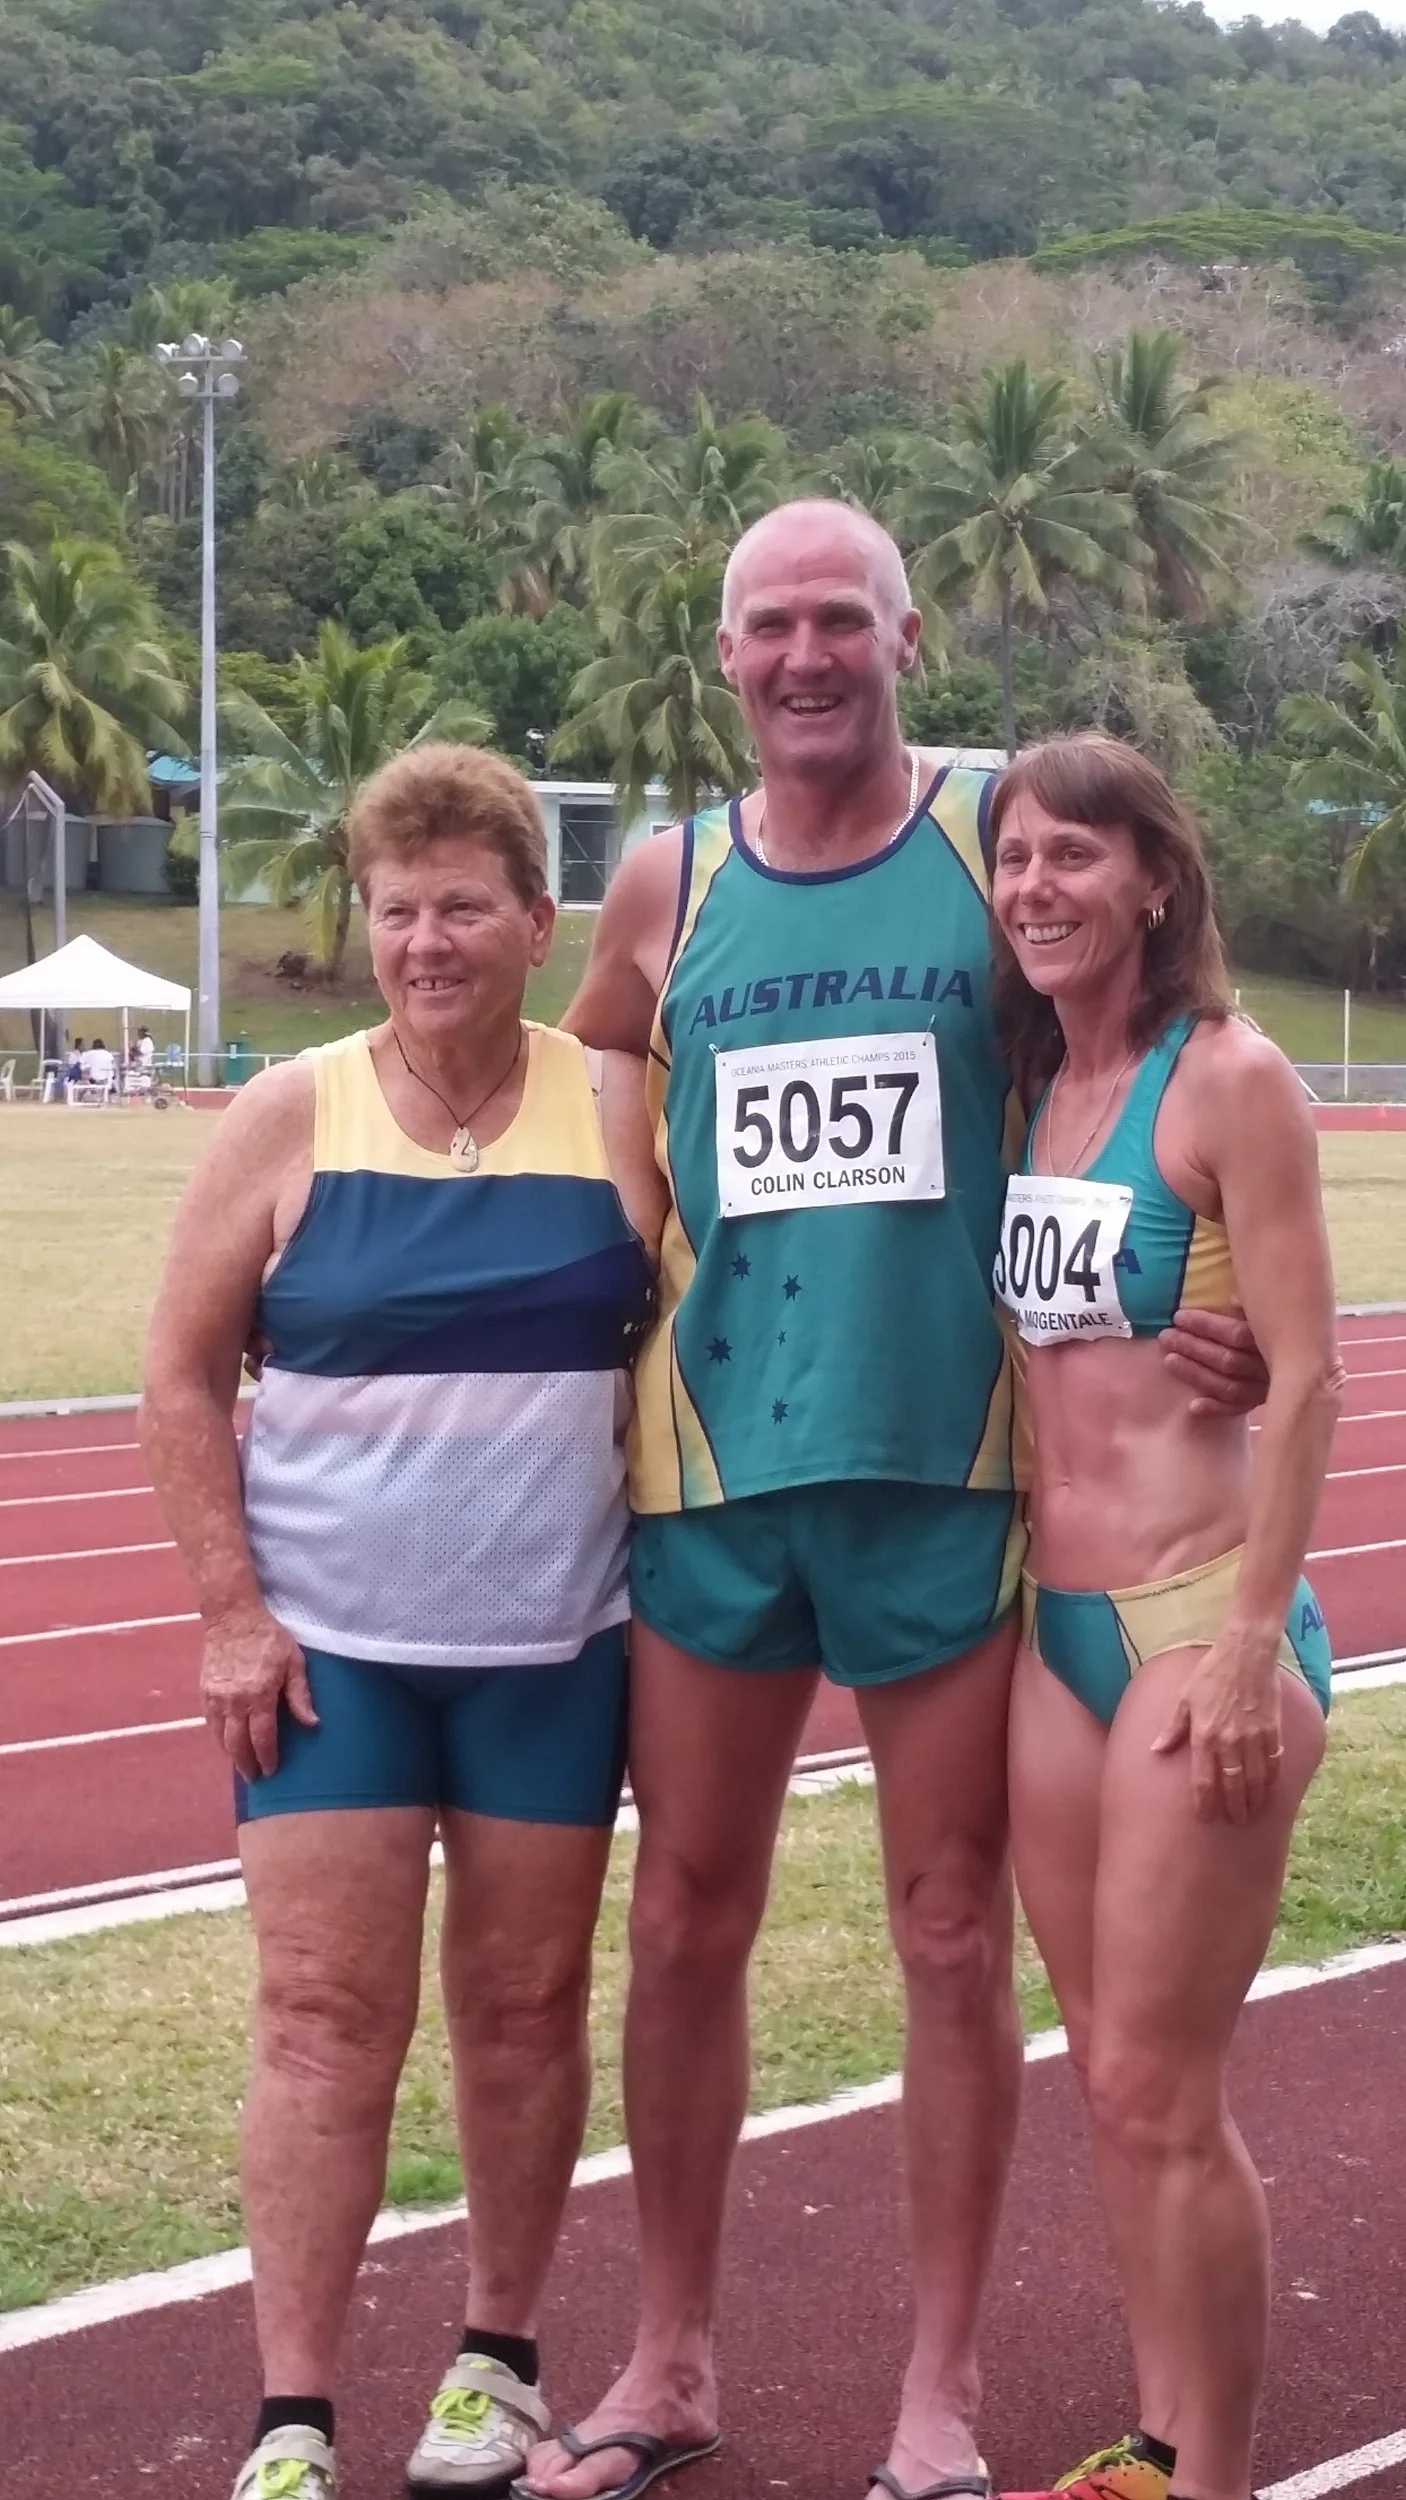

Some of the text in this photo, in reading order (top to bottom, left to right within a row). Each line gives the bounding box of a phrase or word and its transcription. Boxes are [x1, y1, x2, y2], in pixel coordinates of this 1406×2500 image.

[688, 965, 975, 1035] AUSTRALIA
[730, 1050, 917, 1077] OCEANIA MASTERS ATHLETIC CHAMPS 2015
[732, 1071, 920, 1169] 5057
[751, 1166, 906, 1196] COLIN CLARSON
[1024, 1310, 1114, 1331] MOGENTALE
